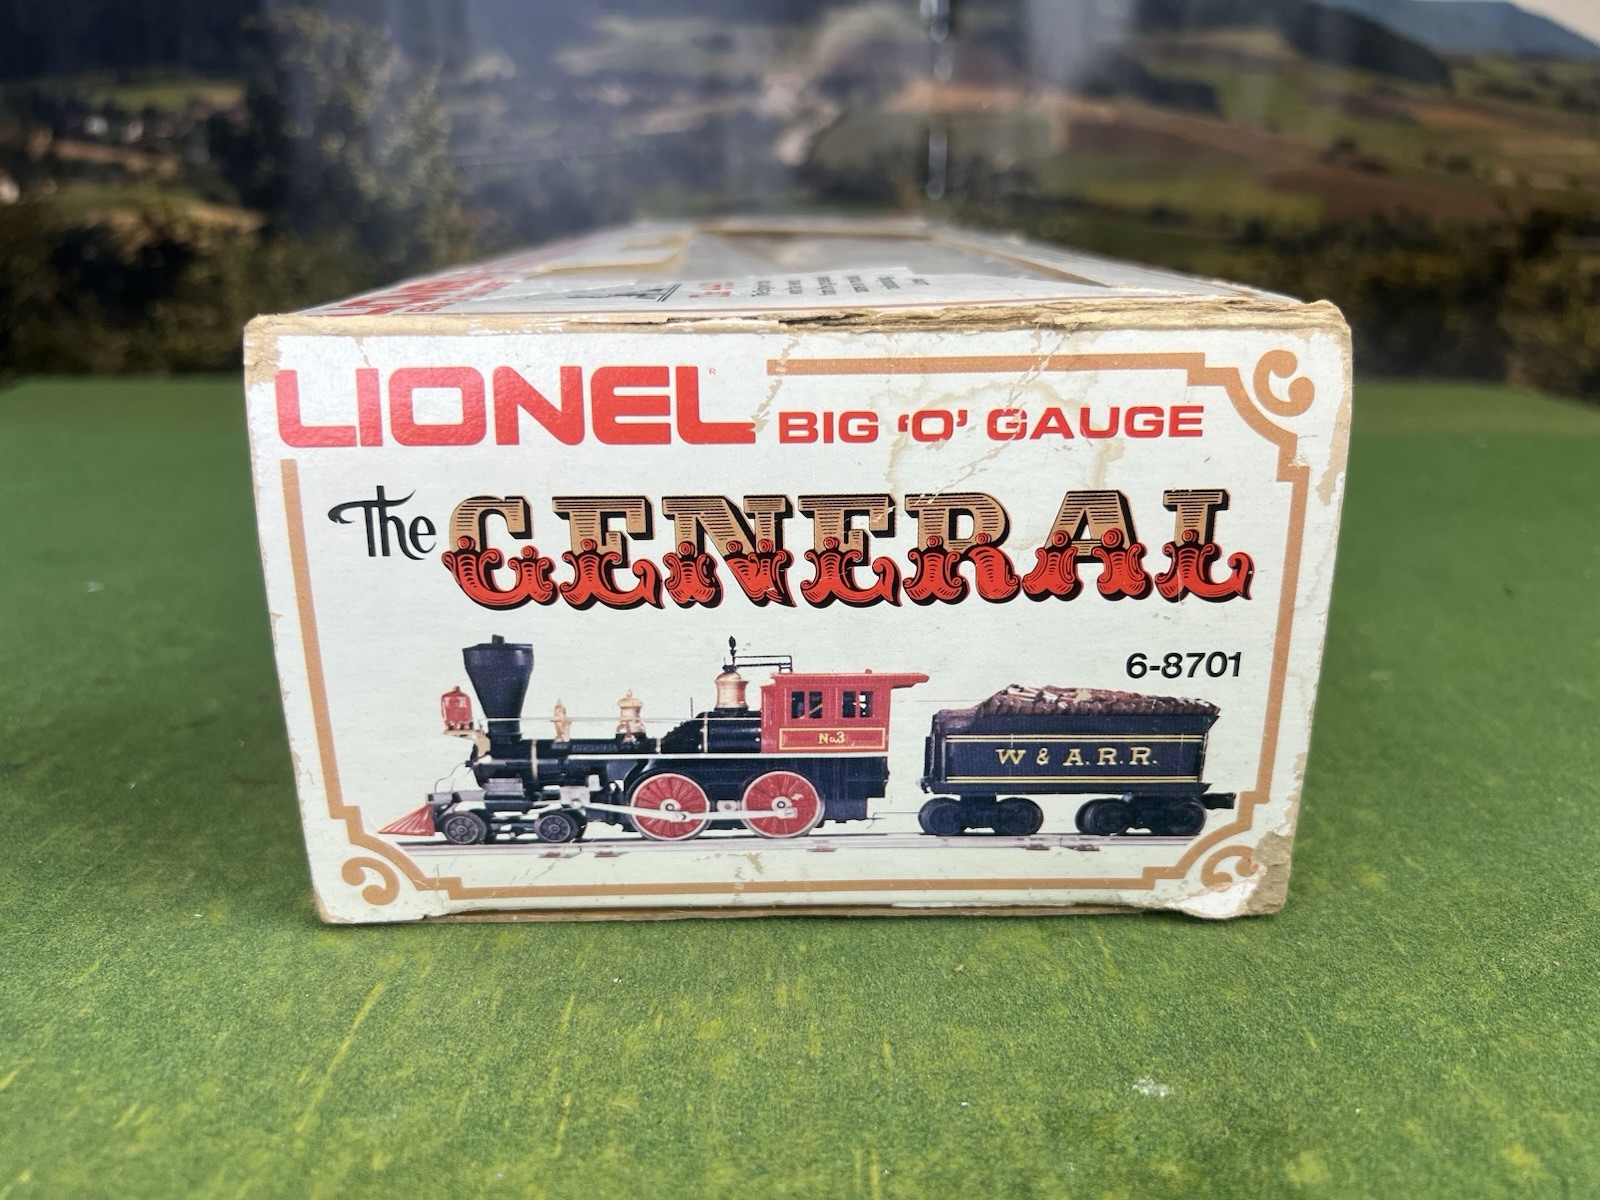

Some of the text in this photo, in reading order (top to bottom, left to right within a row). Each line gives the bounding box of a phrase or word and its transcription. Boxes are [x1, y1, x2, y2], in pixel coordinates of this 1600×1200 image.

[275, 366, 756, 447] LIONEL
[778, 410, 879, 444] BIG
[986, 405, 1204, 441] GAUGE
[328, 485, 1254, 611] The GENERAL
[1125, 651, 1242, 679] 6-8701
[994, 747, 1027, 765] W
[1035, 747, 1050, 766] &
